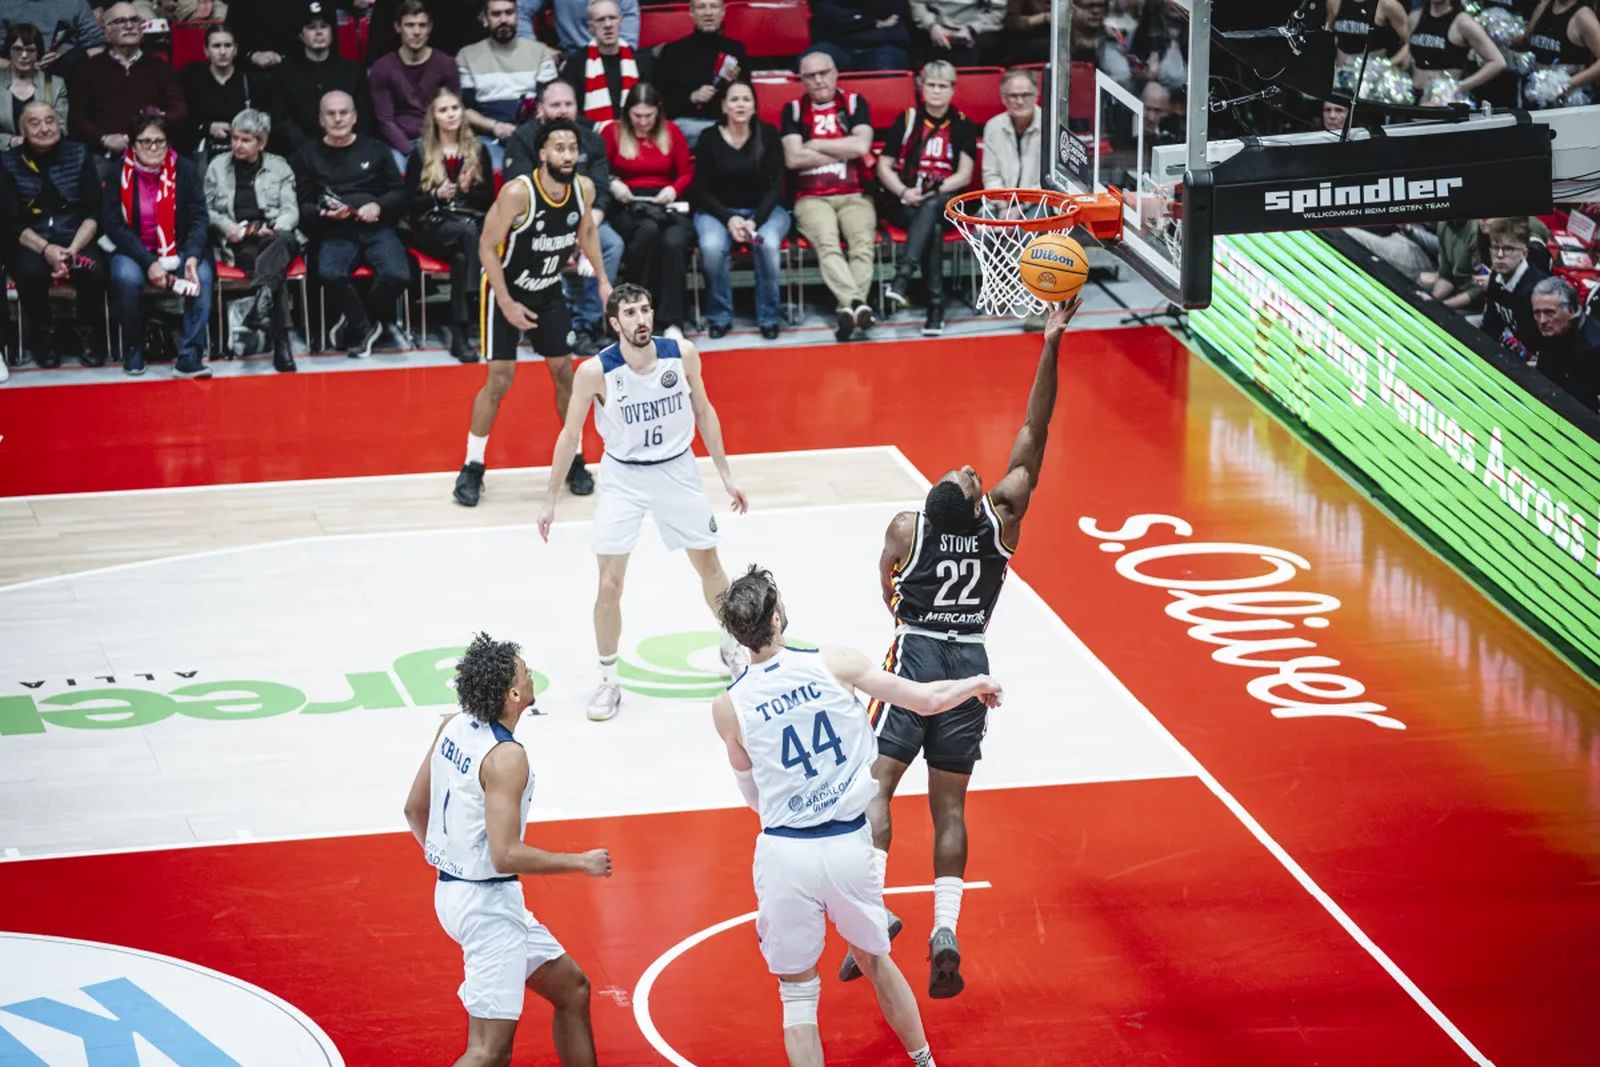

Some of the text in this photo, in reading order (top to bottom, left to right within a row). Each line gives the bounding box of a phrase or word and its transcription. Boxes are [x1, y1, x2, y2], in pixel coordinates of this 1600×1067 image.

[813, 114, 837, 135] 24
[1265, 177, 1463, 213] spindler
[1303, 202, 1450, 219] WILLKOMMEN BEIM BESTEN TEAM
[541, 255, 560, 276] 10
[1031, 248, 1074, 267] Wilson
[643, 425, 663, 448] 16
[1376, 336, 1476, 474] Venues
[1483, 426, 1586, 562] Across
[940, 533, 980, 553] STOVE
[933, 558, 981, 607] 22
[1078, 513, 1407, 730] s.Oliver
[756, 681, 822, 722] TOMIC
[781, 710, 848, 780] 44
